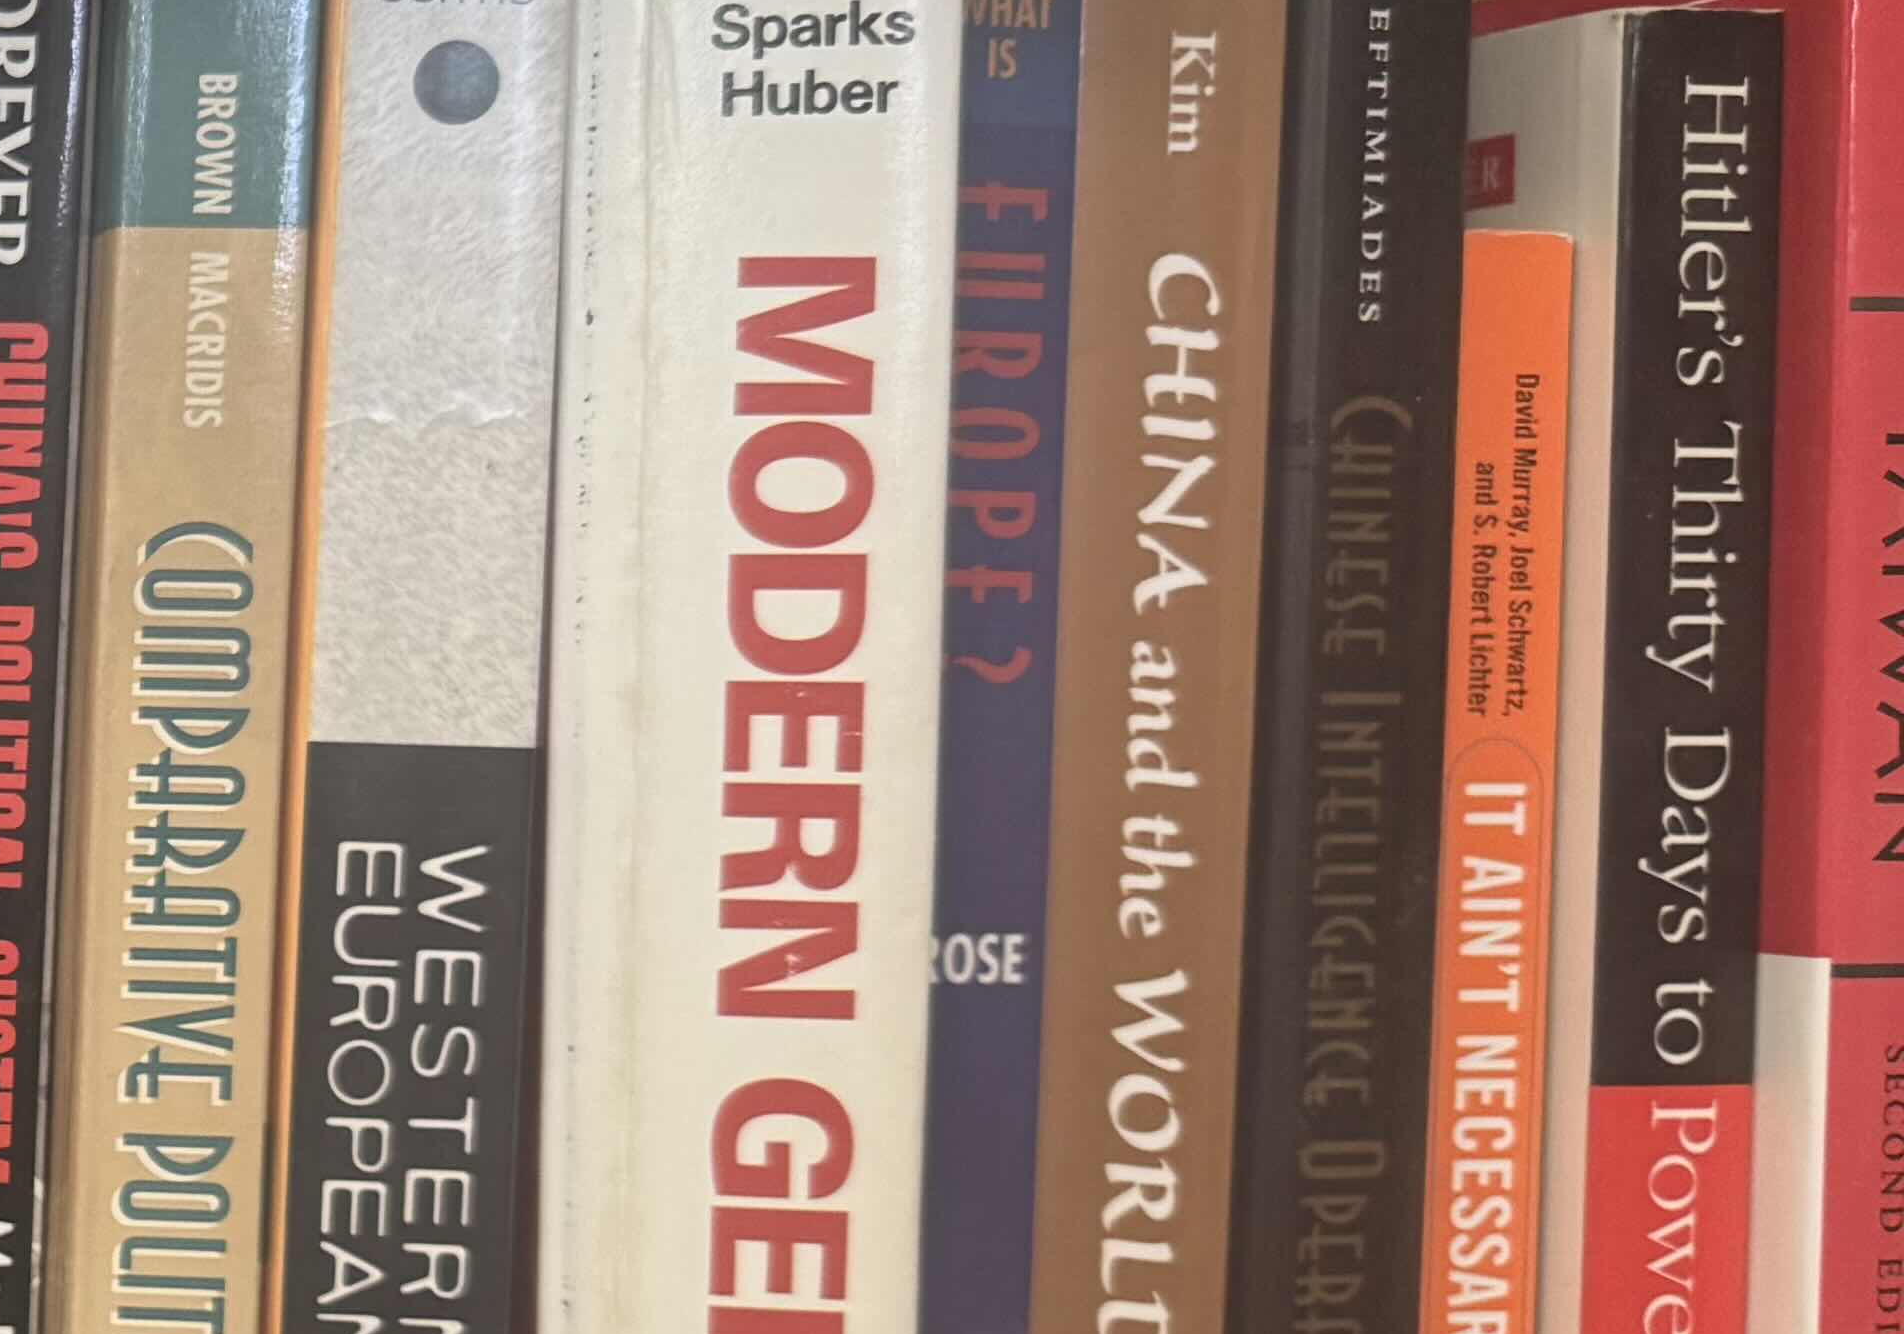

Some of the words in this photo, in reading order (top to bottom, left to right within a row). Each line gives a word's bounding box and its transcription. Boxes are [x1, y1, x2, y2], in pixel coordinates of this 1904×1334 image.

[710, 0, 916, 61] Sparks
[719, 70, 900, 118] Huber
[1166, 30, 1218, 156] Kim
[192, 73, 240, 216] BROWN
[1357, 7, 1393, 323] EFTIMIADES
[1675, 75, 1755, 387] Hitler's
[181, 250, 231, 430] MACRIDIS
[1513, 373, 1541, 440] David
[1132, 251, 1224, 616] CHINA
[1473, 461, 1497, 507] and
[1320, 394, 1414, 657] CHINESE
[1470, 543, 1498, 619] Robert
[1509, 544, 1535, 589] Joel
[1644, 419, 1747, 694] Thirty
[716, 254, 879, 1021] MODERN
[1466, 625, 1495, 719] Lichter
[1124, 638, 1200, 792] and
[112, 520, 255, 1108] COMPARATIVE
[1117, 811, 1199, 940] the
[1463, 781, 1528, 836] IT
[1637, 726, 1733, 945] Days
[1457, 855, 1525, 1013] AIN'T
[1652, 977, 1716, 1067] to
